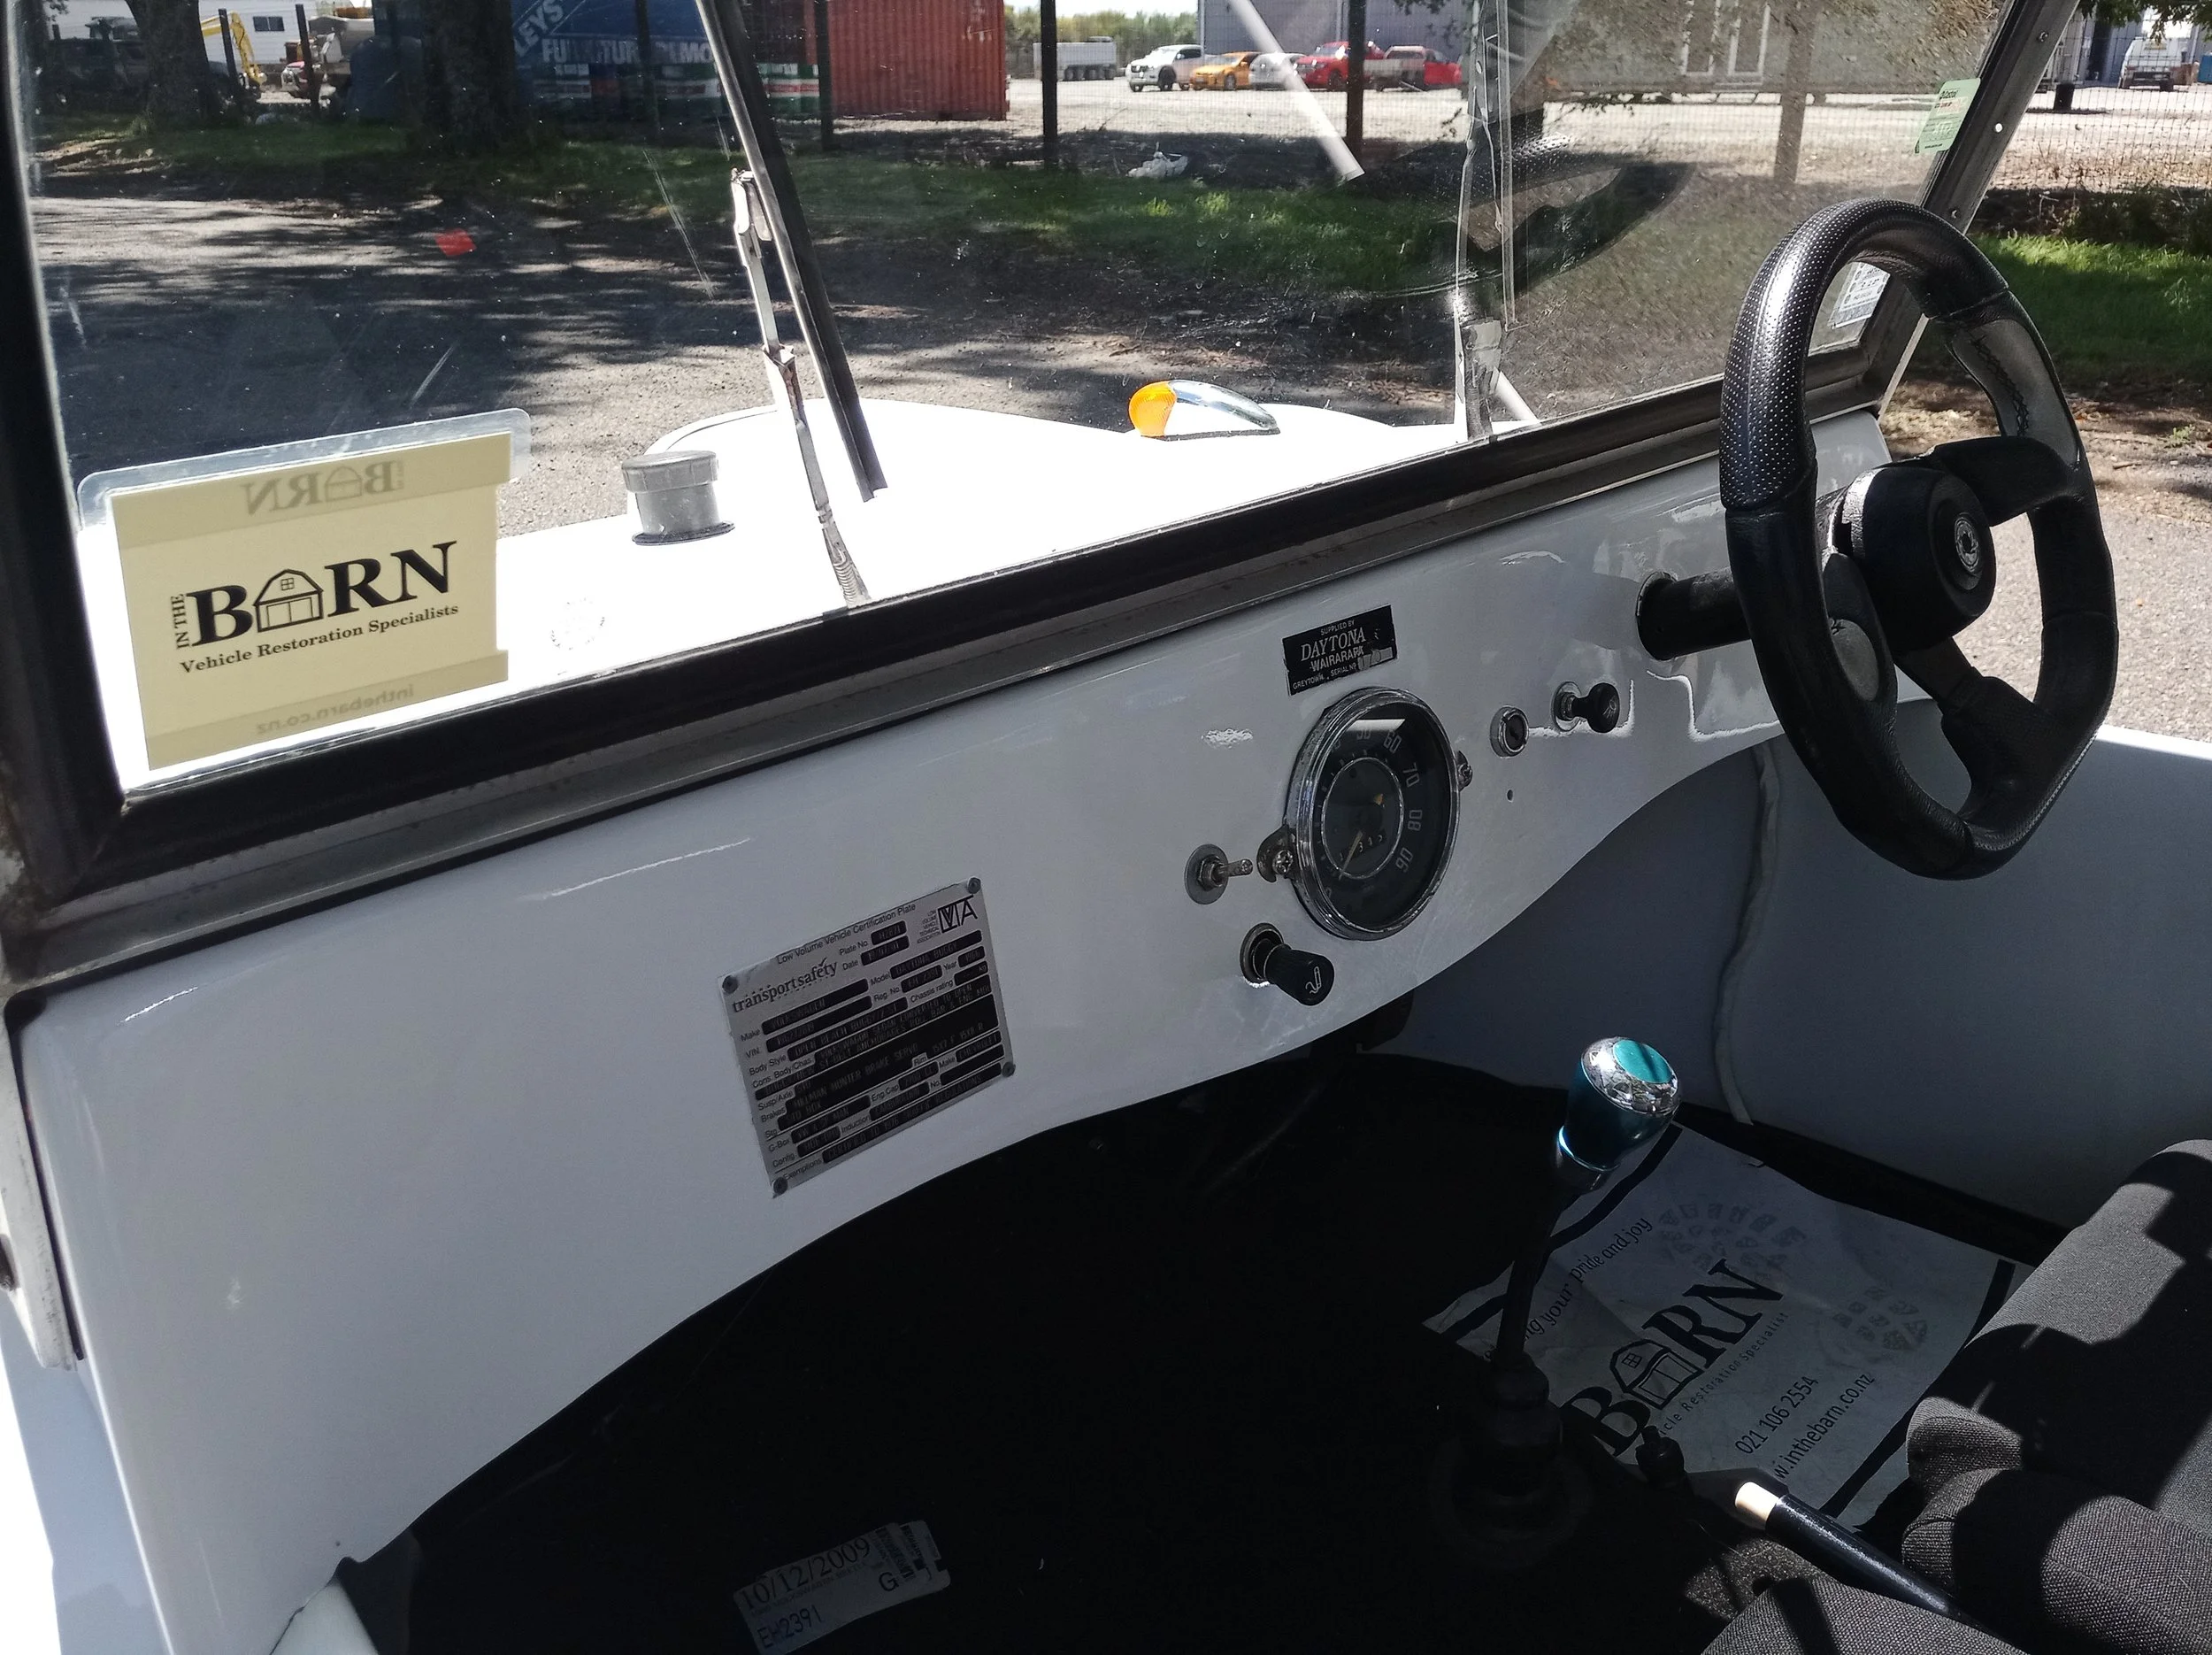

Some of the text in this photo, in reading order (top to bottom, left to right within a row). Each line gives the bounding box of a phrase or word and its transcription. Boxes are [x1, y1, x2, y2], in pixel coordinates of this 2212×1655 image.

[171, 593, 186, 629] THE
[180, 603, 459, 674] Vehicle Restoration Specialists
[1320, 621, 1347, 635] SUPPLIED
[1301, 627, 1366, 661] DAYTONA
[1383, 732, 1402, 753] 60
[1402, 762, 1420, 788] 70
[1408, 810, 1422, 831] 80
[1395, 847, 1413, 873] 90
[777, 902, 916, 965] Low Volume Vehicle Certification Plate
[839, 943, 856, 956] Plate
[841, 958, 858, 971] Date
[870, 972, 890, 986] Model
[749, 1061, 768, 1076] Body
[761, 1105, 785, 1123] Brakes
[1539, 1217, 1654, 1328] your pride and joy
[1681, 1358, 1743, 1413] Restoration
[1739, 1312, 1789, 1361] Specialist
[1735, 1375, 1820, 1455] 021 106 2554
[1774, 1374, 1875, 1481] w.inthebarn.co.nz
[741, 1536, 871, 1610] 10/12/2009
[878, 1571, 899, 1592] G
